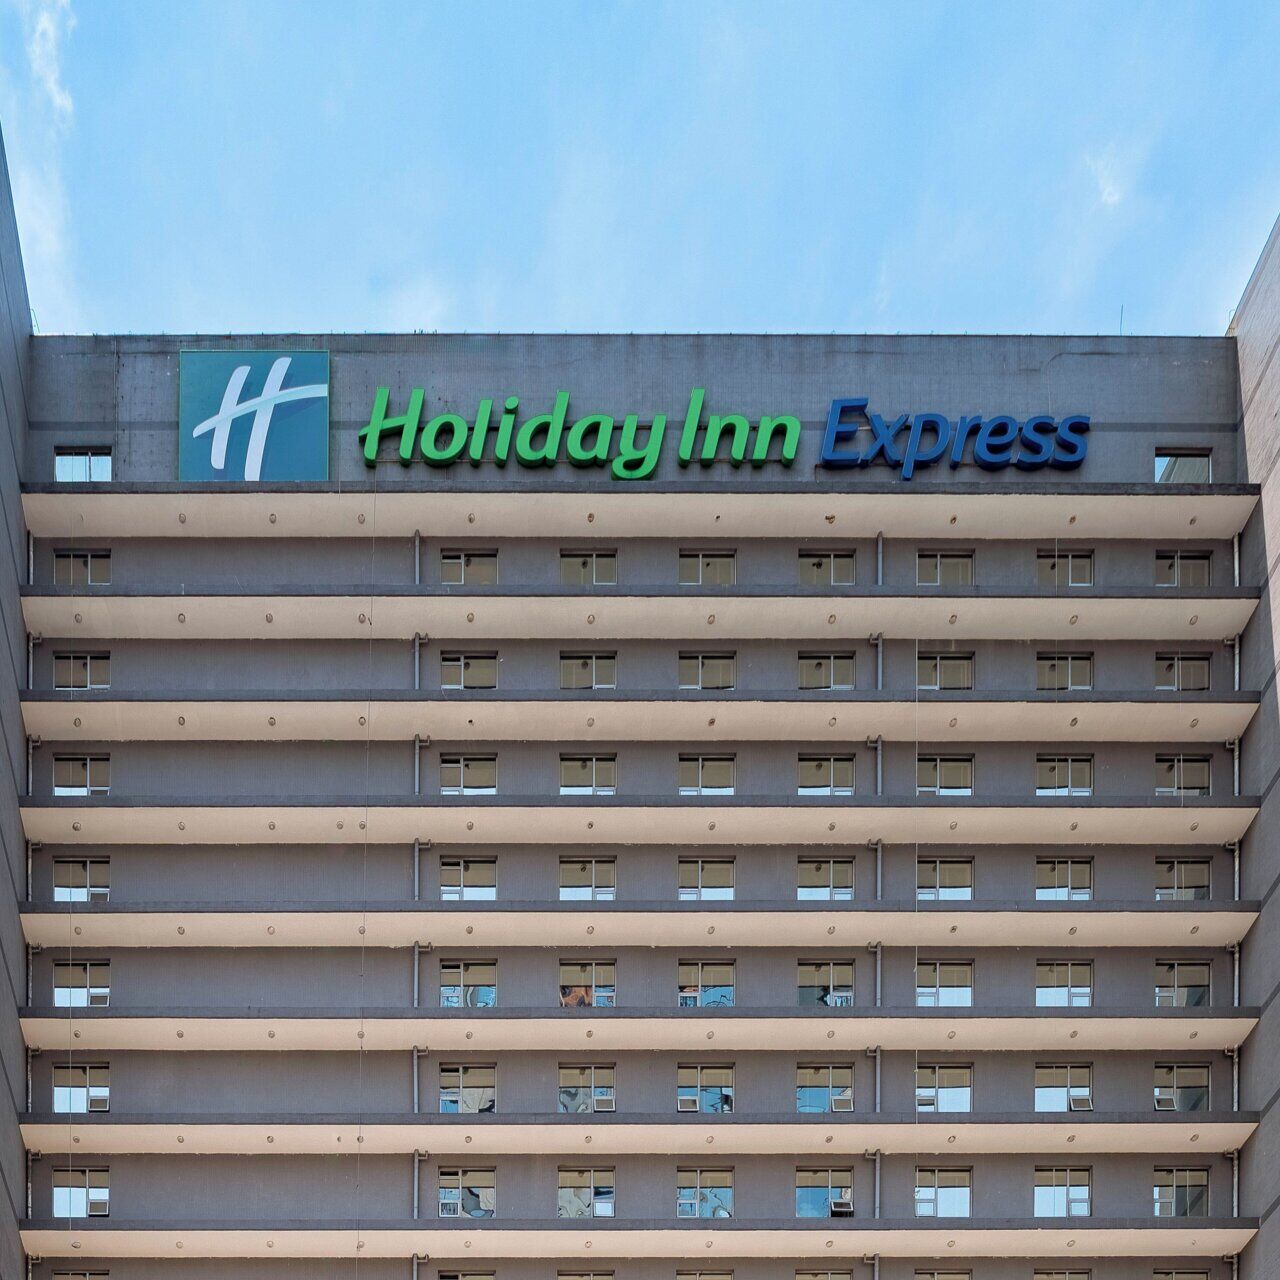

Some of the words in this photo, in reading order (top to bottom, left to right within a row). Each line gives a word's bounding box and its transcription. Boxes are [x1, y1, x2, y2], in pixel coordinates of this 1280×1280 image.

[358, 386, 668, 480] Holiday
[677, 386, 802, 468] Inn
[820, 397, 1091, 480] Express
